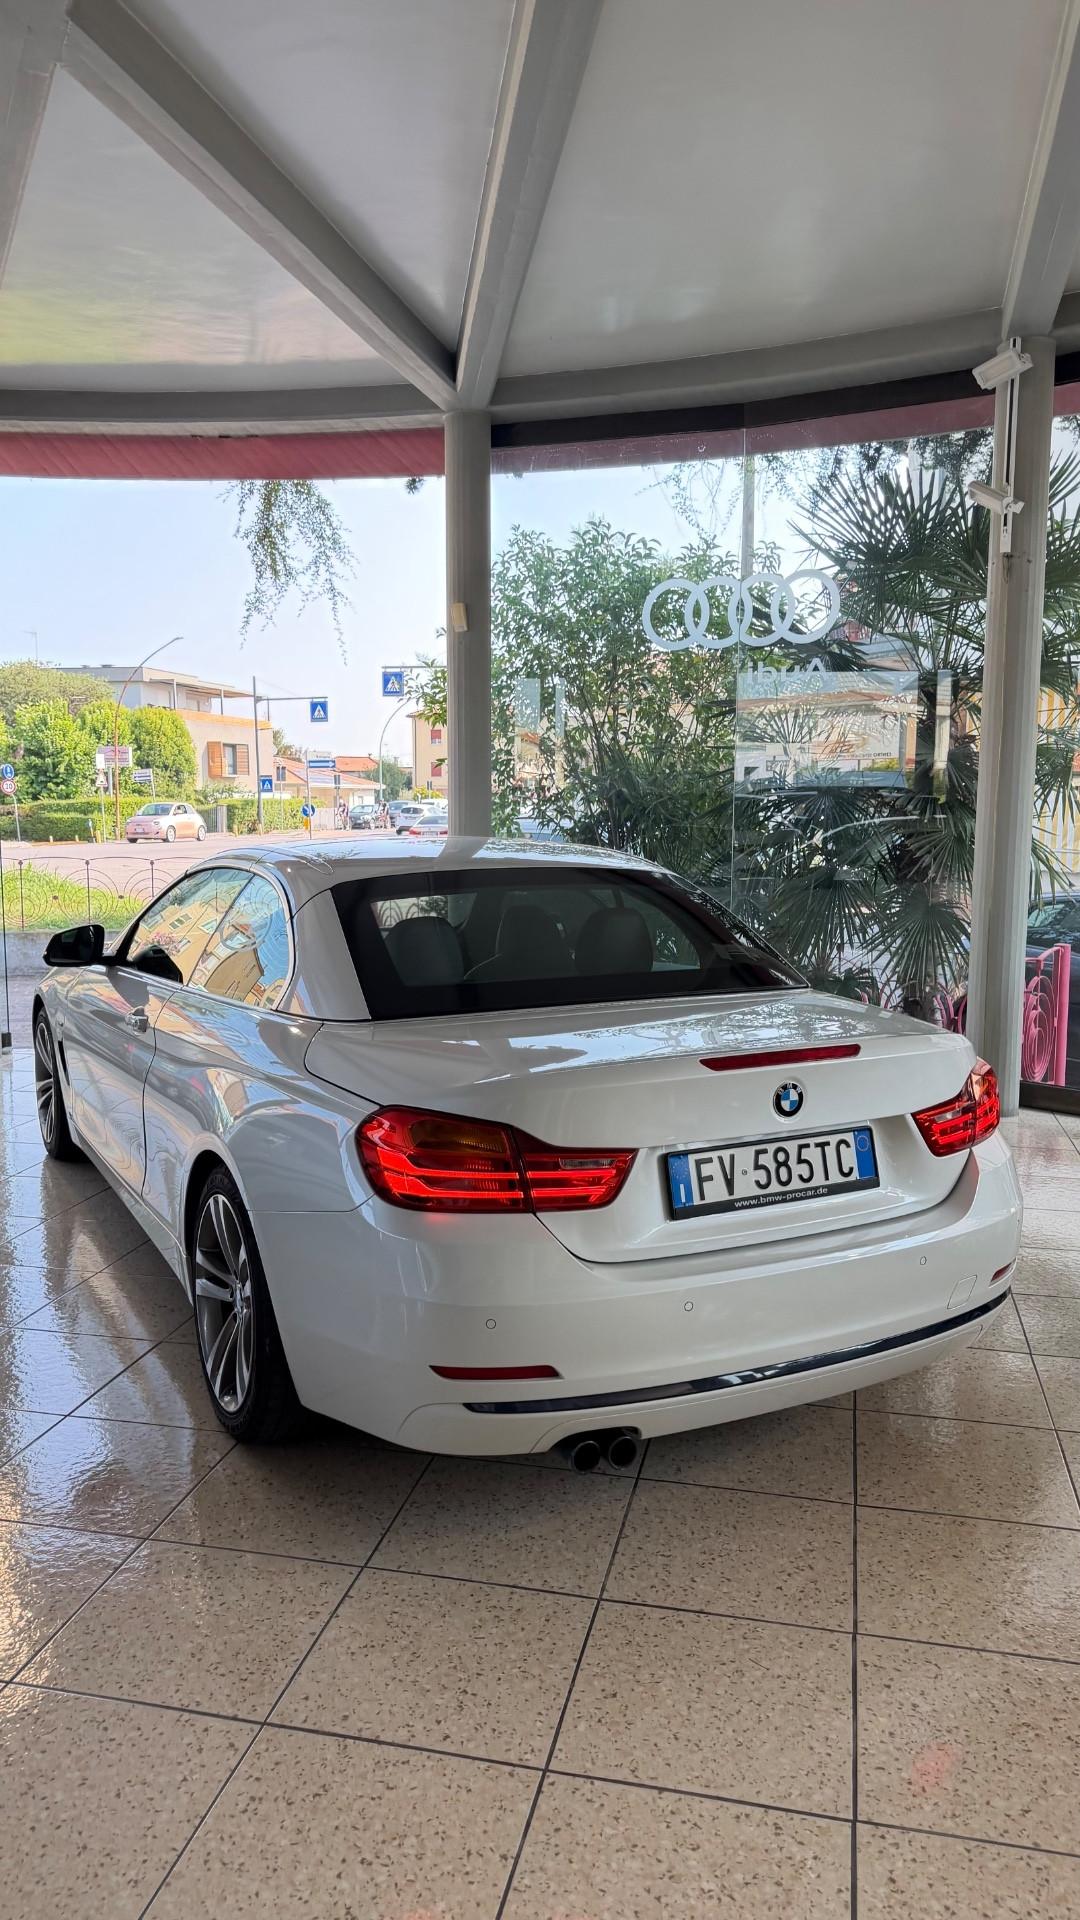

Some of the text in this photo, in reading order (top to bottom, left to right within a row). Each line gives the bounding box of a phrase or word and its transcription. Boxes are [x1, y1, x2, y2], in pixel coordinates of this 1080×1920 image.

[694, 1153, 735, 1201] FV
[753, 1138, 854, 1190] 585TC
[734, 1186, 828, 1208] www.bmw-procar.de
